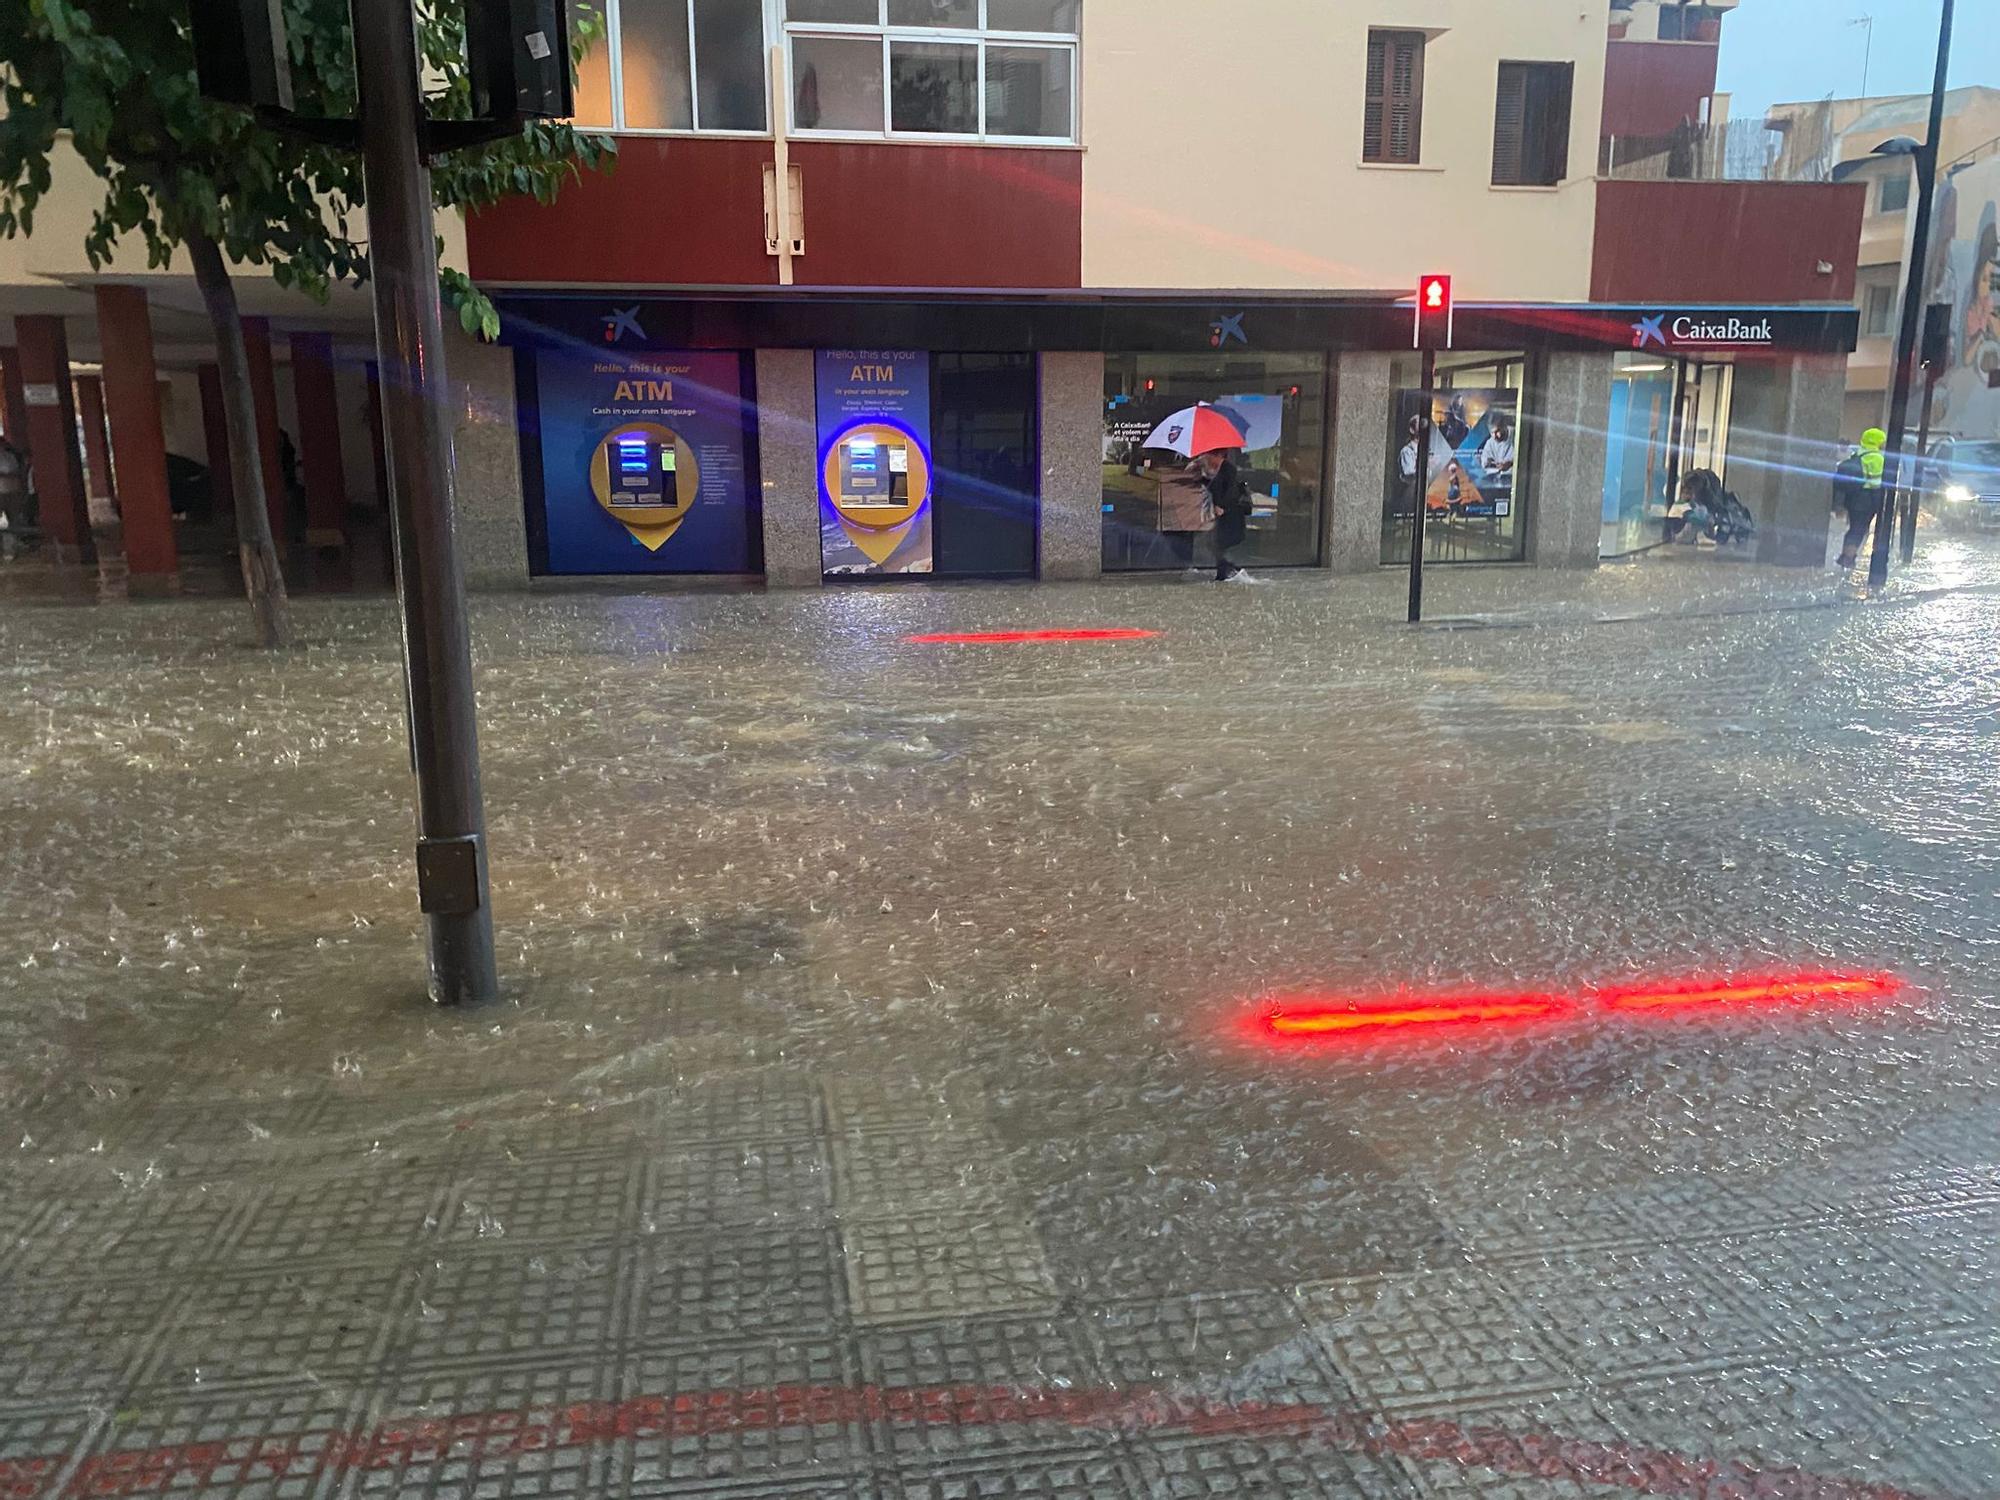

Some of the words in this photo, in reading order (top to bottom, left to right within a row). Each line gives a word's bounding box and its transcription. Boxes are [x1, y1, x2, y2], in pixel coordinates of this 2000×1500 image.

[1672, 316, 1772, 339] CaixaBank
[860, 350, 878, 359] this
[881, 350, 890, 359] is
[892, 351, 915, 361] your
[593, 363, 625, 373] Hello,
[629, 363, 651, 373] this
[652, 363, 661, 373] is
[665, 365, 690, 374] your
[850, 365, 894, 382] ATM
[614, 381, 673, 401] ATM
[592, 407, 611, 415] Cash
[612, 407, 620, 415] in
[622, 408, 640, 416] your
[660, 407, 697, 416] language
